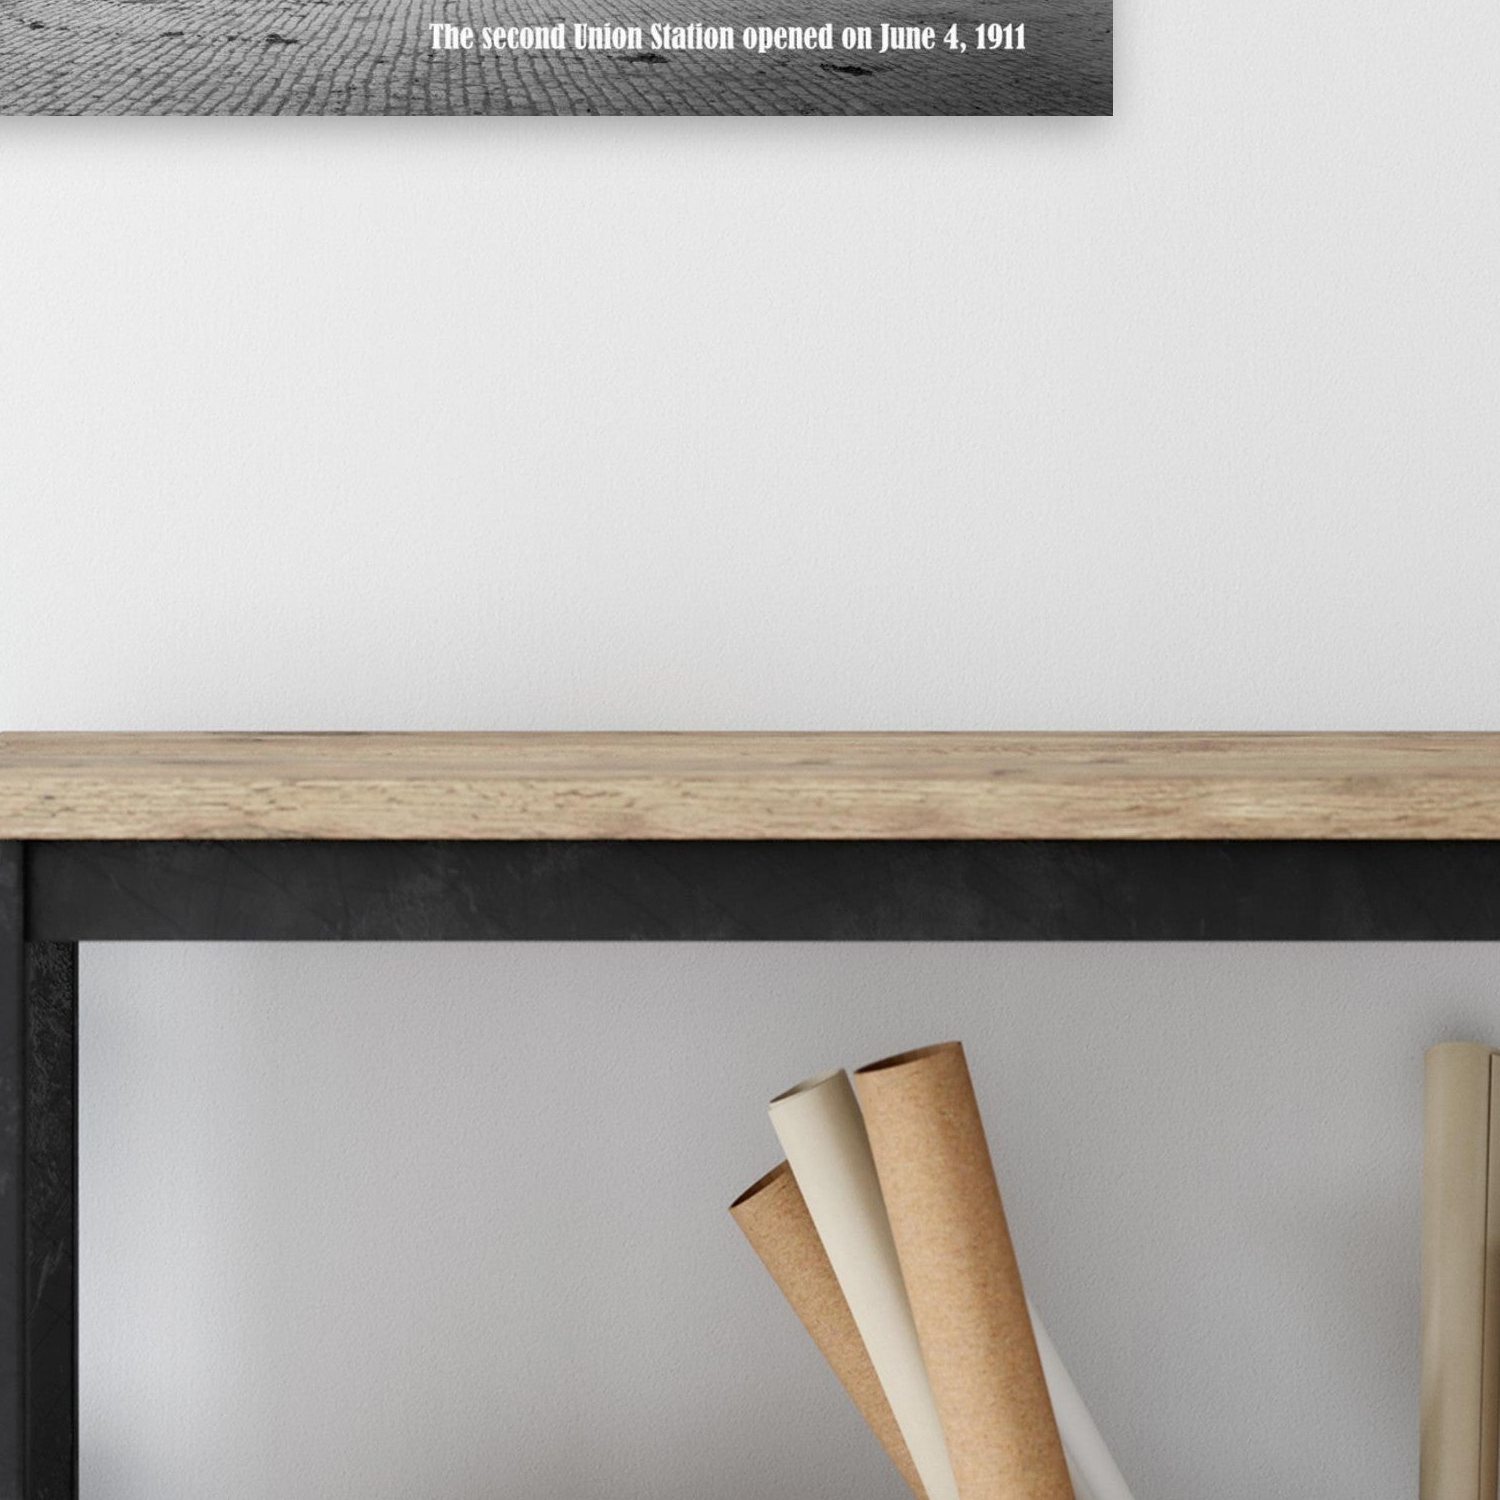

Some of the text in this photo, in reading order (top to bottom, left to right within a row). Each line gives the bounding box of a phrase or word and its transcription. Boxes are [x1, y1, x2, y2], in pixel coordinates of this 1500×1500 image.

[429, 22, 1026, 54] The second Union Station opened on June 4, 1911
